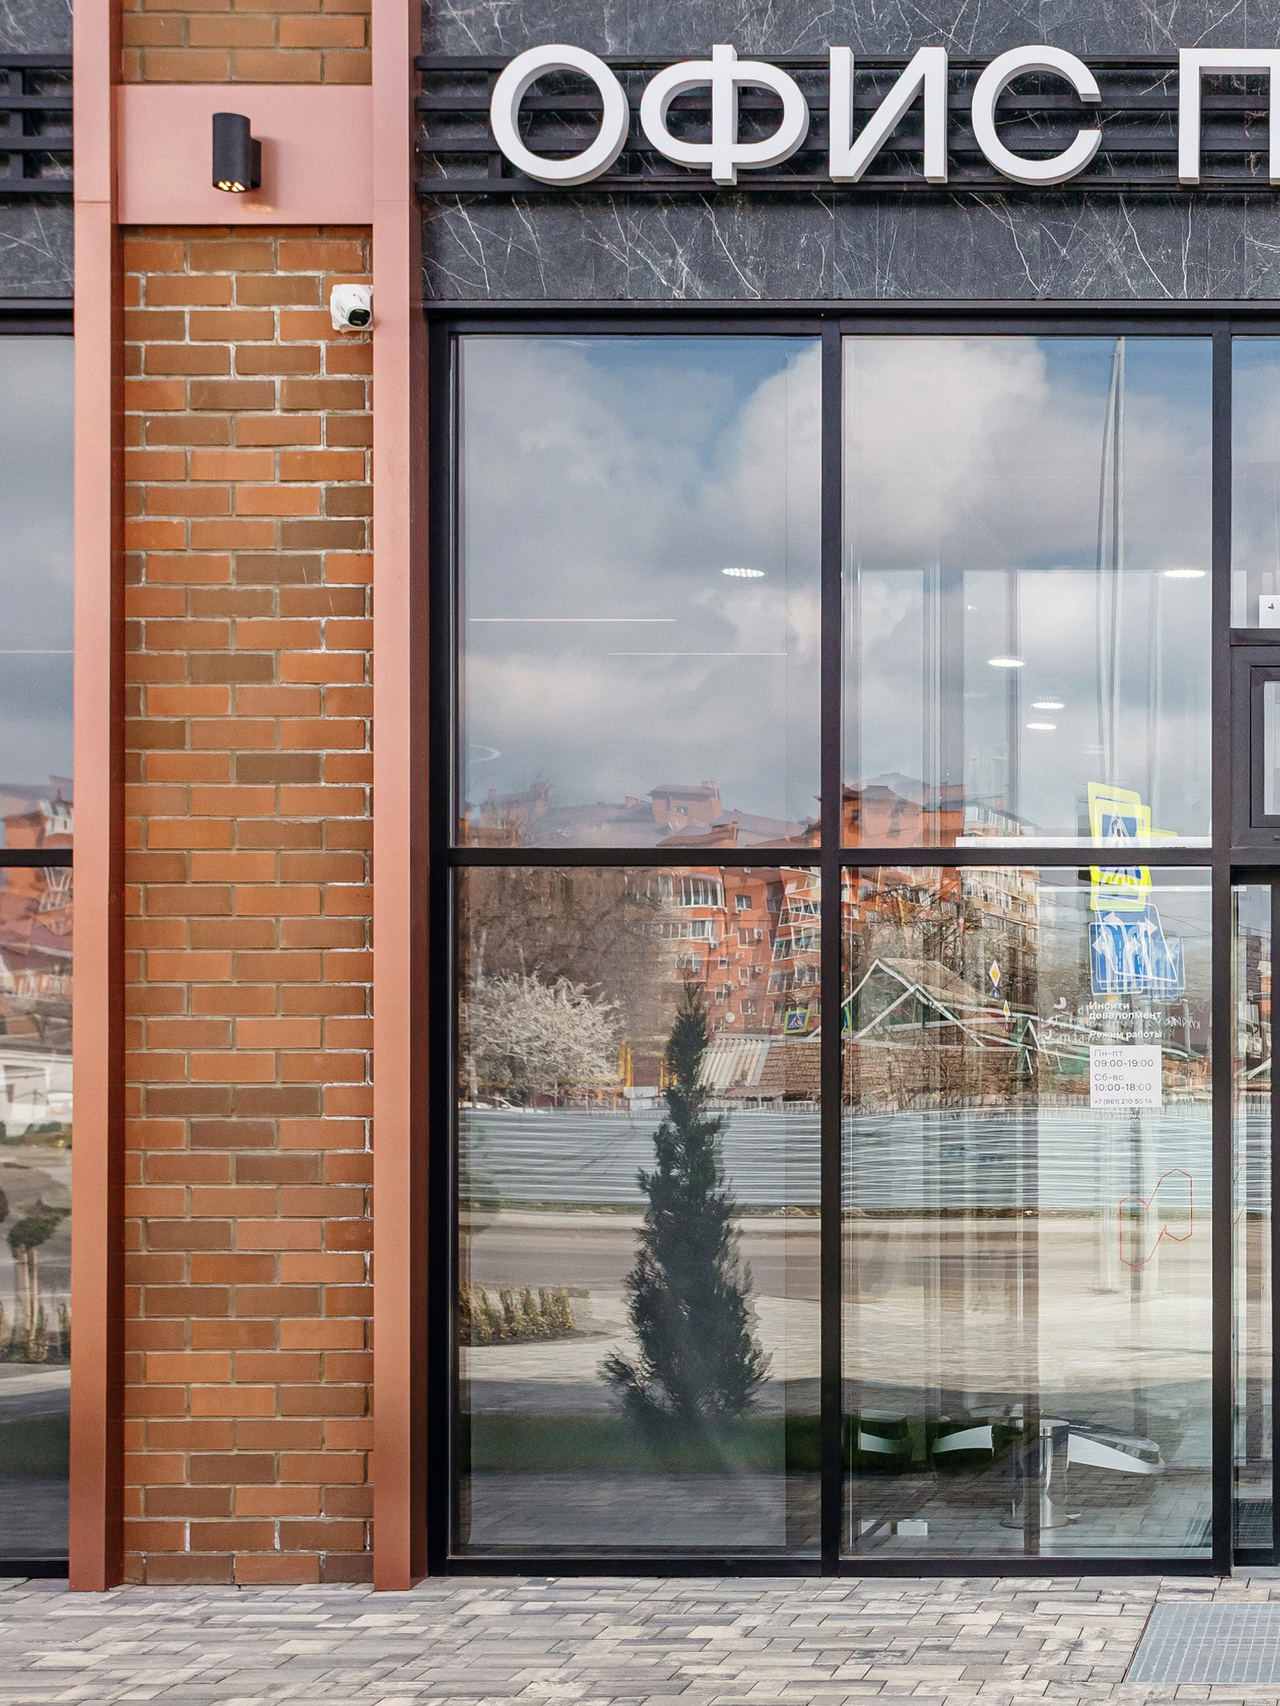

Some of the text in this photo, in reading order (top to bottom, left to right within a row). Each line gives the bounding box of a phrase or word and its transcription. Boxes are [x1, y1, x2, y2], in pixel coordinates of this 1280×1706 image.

[490, 44, 1102, 186] ОФИС
[1088, 1000, 1130, 1010] Инсити
[1088, 1011, 1162, 1021] девелопмент
[1089, 1029, 1163, 1042] Режим работы
[1094, 1048, 1124, 1057] Пн-пт
[1094, 1059, 1154, 1068] 09:00-19:00
[1094, 1073, 1125, 1082] Сб-вс
[1094, 1083, 1152, 1092] 10:00-18:00
